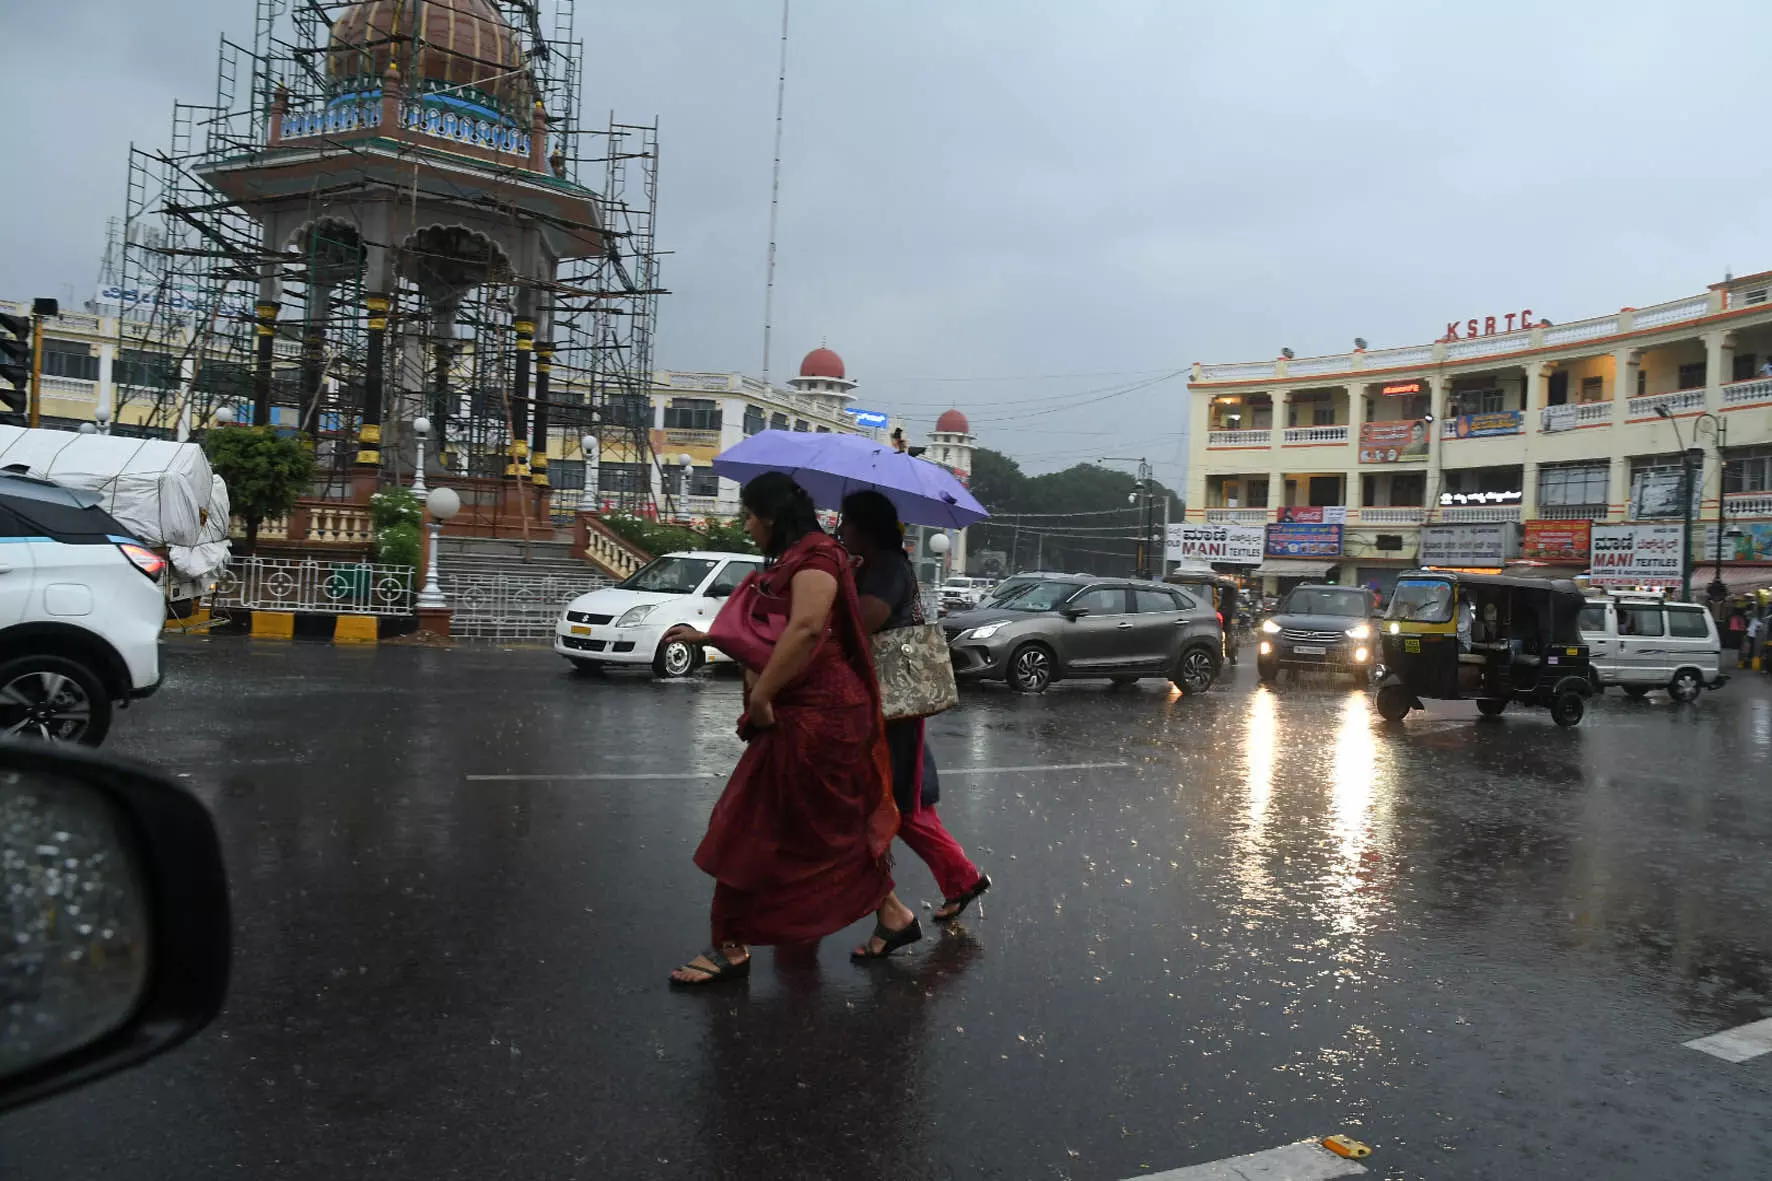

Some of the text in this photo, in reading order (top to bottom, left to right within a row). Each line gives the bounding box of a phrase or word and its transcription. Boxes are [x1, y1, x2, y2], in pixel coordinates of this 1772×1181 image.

[1447, 309, 1532, 341] KSRTC
[1182, 541, 1261, 557] MANI TEXTILES
[1592, 552, 1678, 567] MANI TEXTILES
